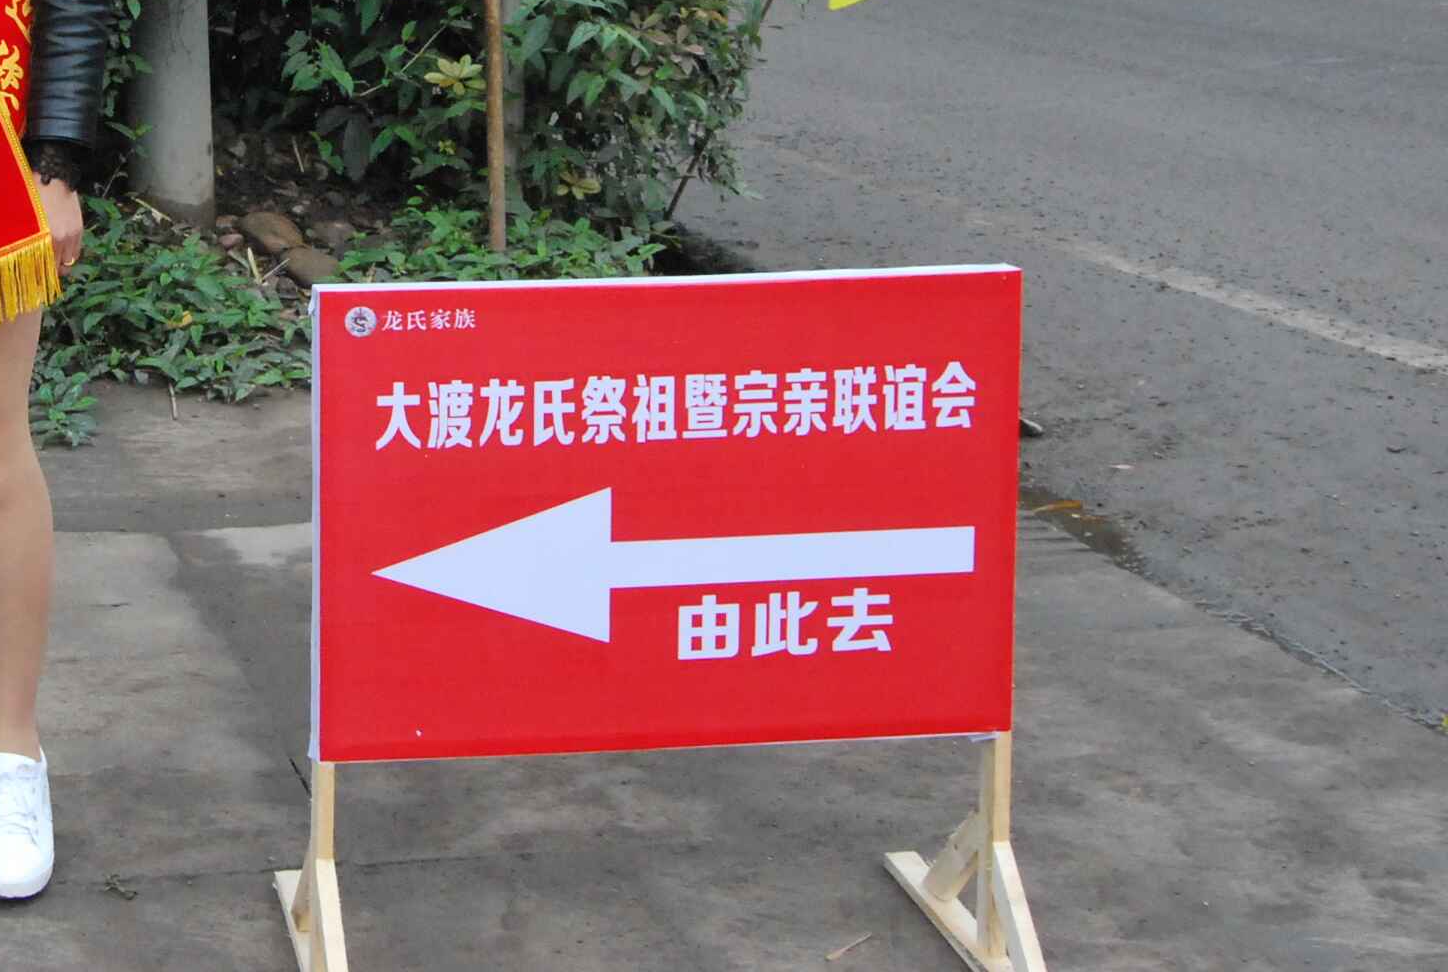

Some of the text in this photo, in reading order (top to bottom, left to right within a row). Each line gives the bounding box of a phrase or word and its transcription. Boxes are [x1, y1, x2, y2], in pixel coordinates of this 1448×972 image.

[381, 308, 476, 331] 龙氏家族
[375, 361, 976, 450] 大渡龙氏祭祖暨宗亲联谊会
[677, 588, 894, 660] 由此去
